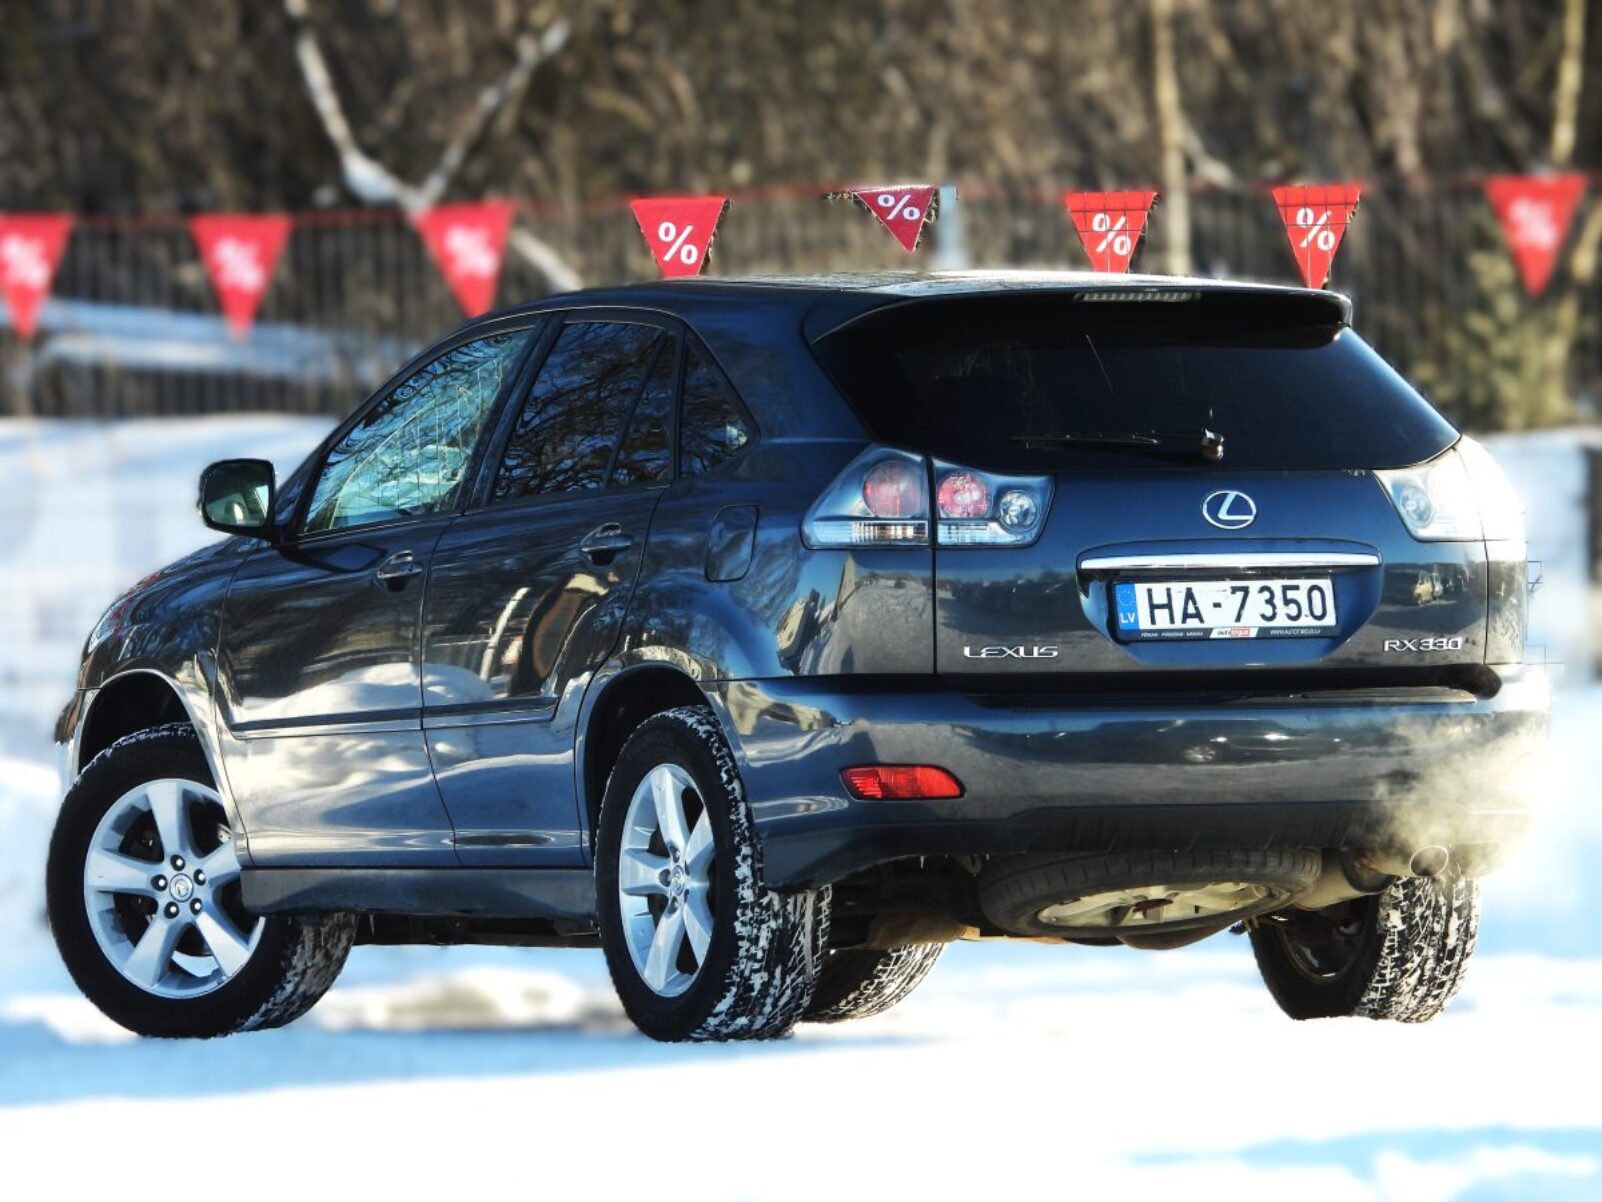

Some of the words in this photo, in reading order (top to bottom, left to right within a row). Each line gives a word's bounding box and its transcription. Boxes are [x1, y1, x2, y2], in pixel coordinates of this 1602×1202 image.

[873, 191, 920, 222] %
[657, 221, 699, 266] %
[1091, 211, 1131, 256] %
[1294, 206, 1336, 252] %
[1120, 612, 1136, 624] LV
[1146, 584, 1328, 626] HA-7350
[963, 645, 1059, 659] LEXUS
